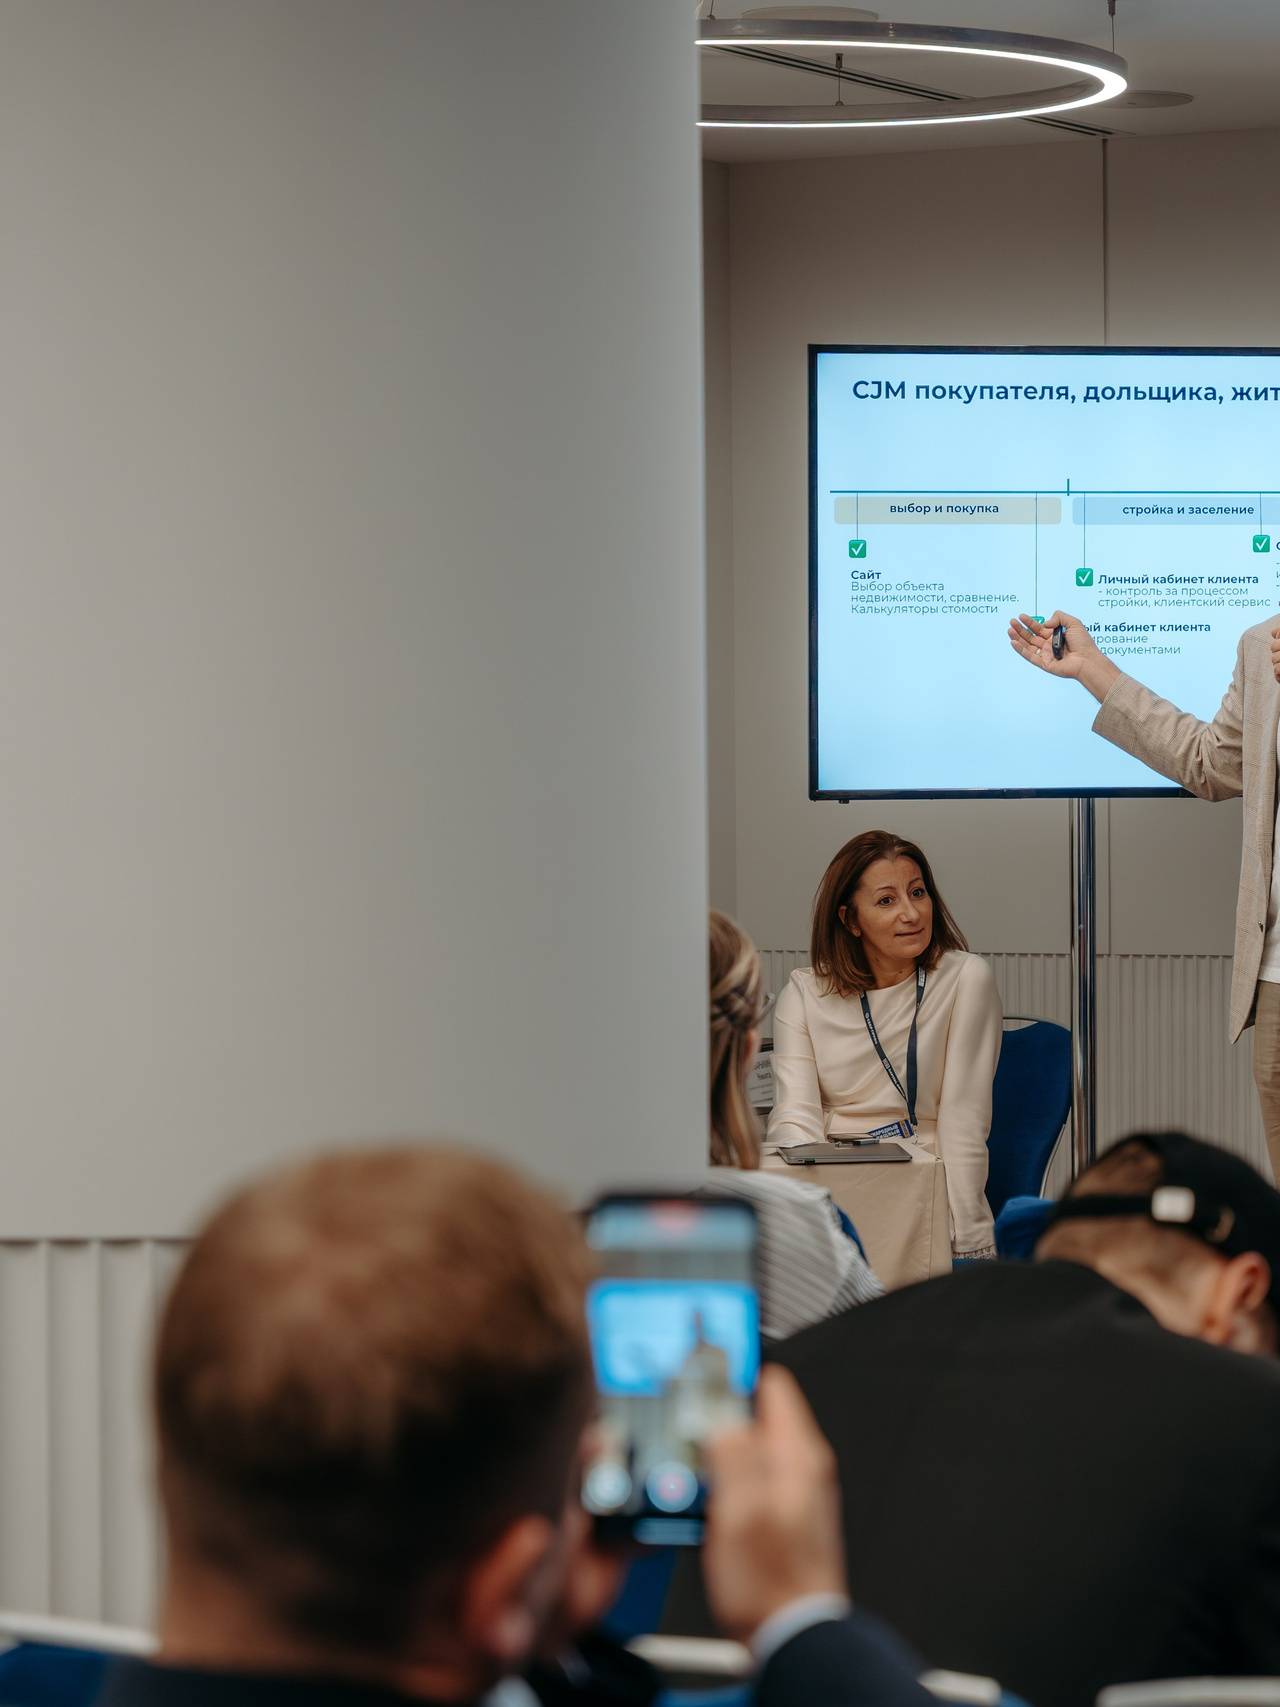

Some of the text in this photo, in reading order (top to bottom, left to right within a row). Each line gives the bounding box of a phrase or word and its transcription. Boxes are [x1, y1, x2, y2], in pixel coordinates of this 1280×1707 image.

[852, 380, 906, 400] CJM
[915, 383, 1076, 404] покупателя,
[1083, 385, 1224, 405] дольщика,
[889, 503, 1000, 515] выбор и покупка
[1122, 504, 1255, 516] стройка и заселение
[850, 569, 882, 580] Сайт
[1098, 573, 1259, 585] Личный кабинет клиента
[851, 580, 945, 593] Выбор объекта
[1103, 587, 1249, 598] контроль за процессом
[851, 593, 1020, 604] недвижимости, сравнение.
[1098, 597, 1271, 608] стройки, клиентский сервис
[851, 604, 998, 616] Калькуляторы стомости
[1104, 622, 1156, 632] кабинет
[1159, 623, 1211, 632] клиента
[1092, 635, 1148, 645] рование
[1101, 645, 1181, 657] документами
